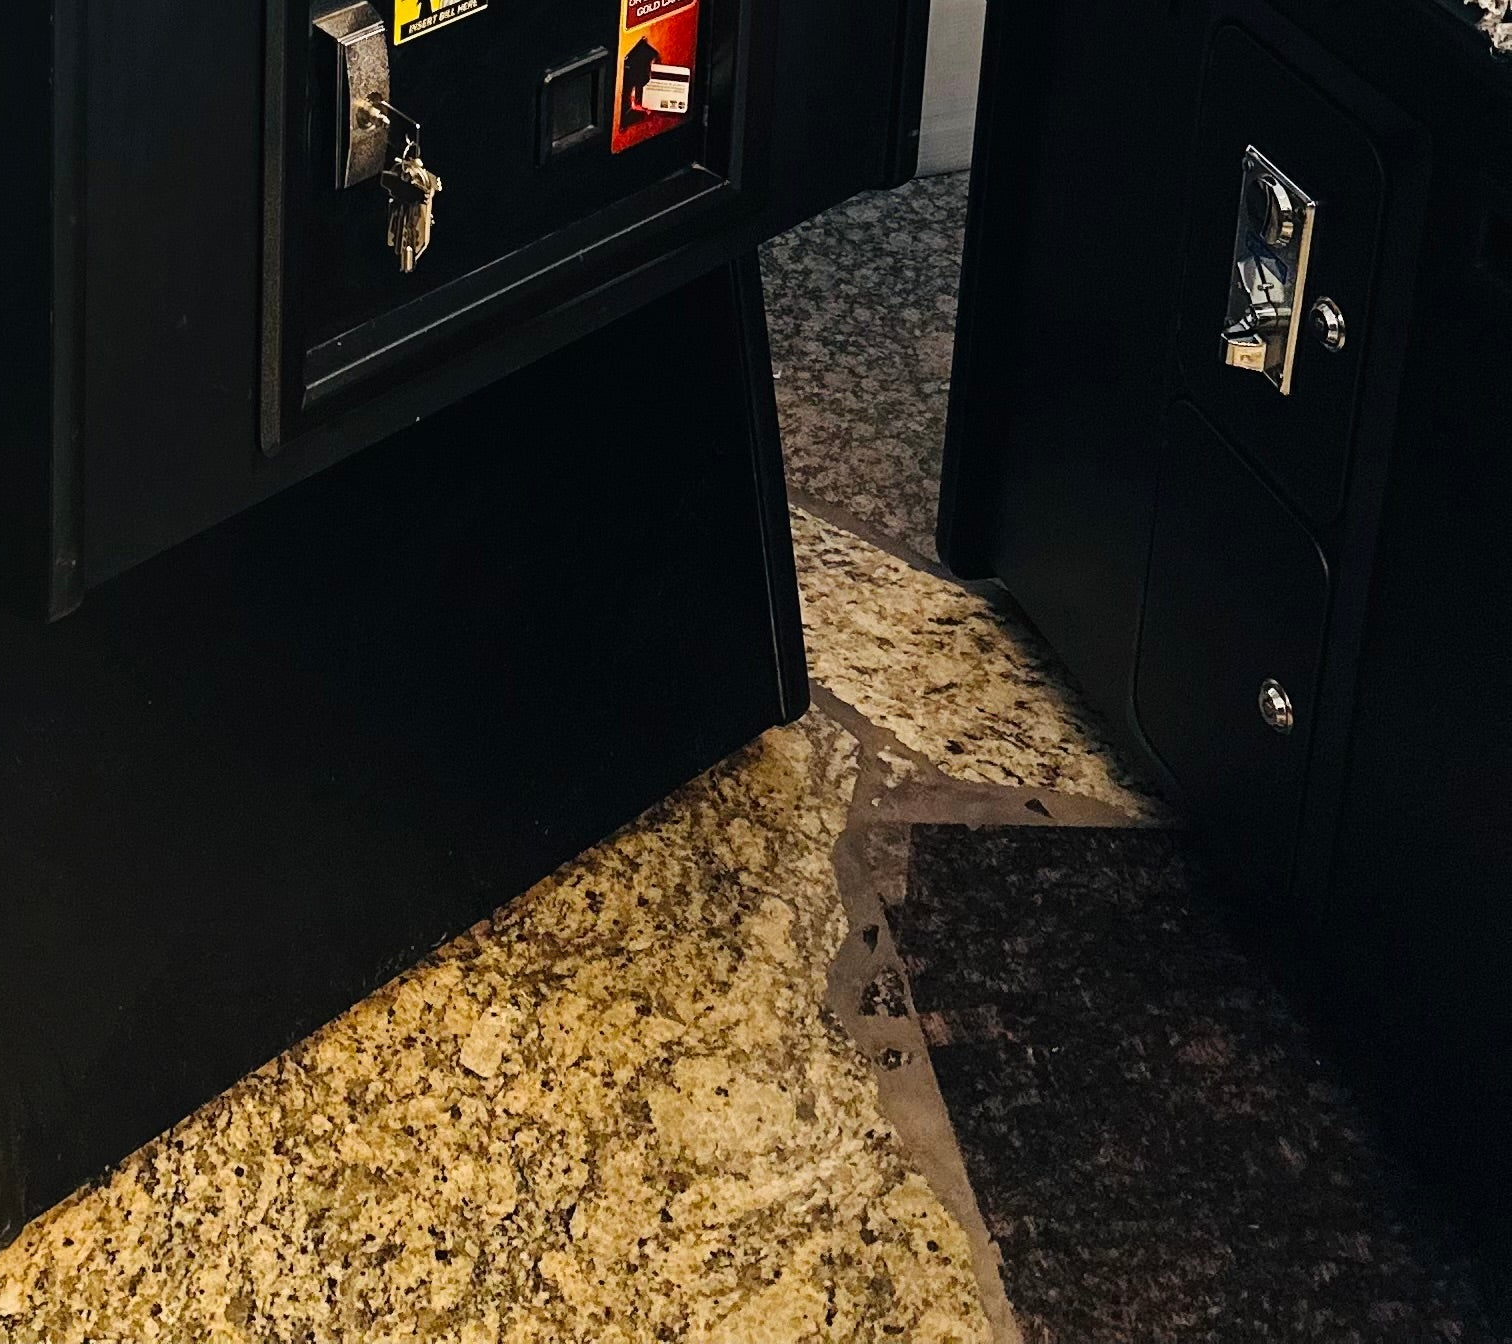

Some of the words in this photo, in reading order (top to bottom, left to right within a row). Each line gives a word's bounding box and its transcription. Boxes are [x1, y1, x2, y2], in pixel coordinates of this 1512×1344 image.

[636, 0, 661, 17] GOLD
[408, 14, 438, 34] INSERT
[439, 9, 456, 22] BILL
